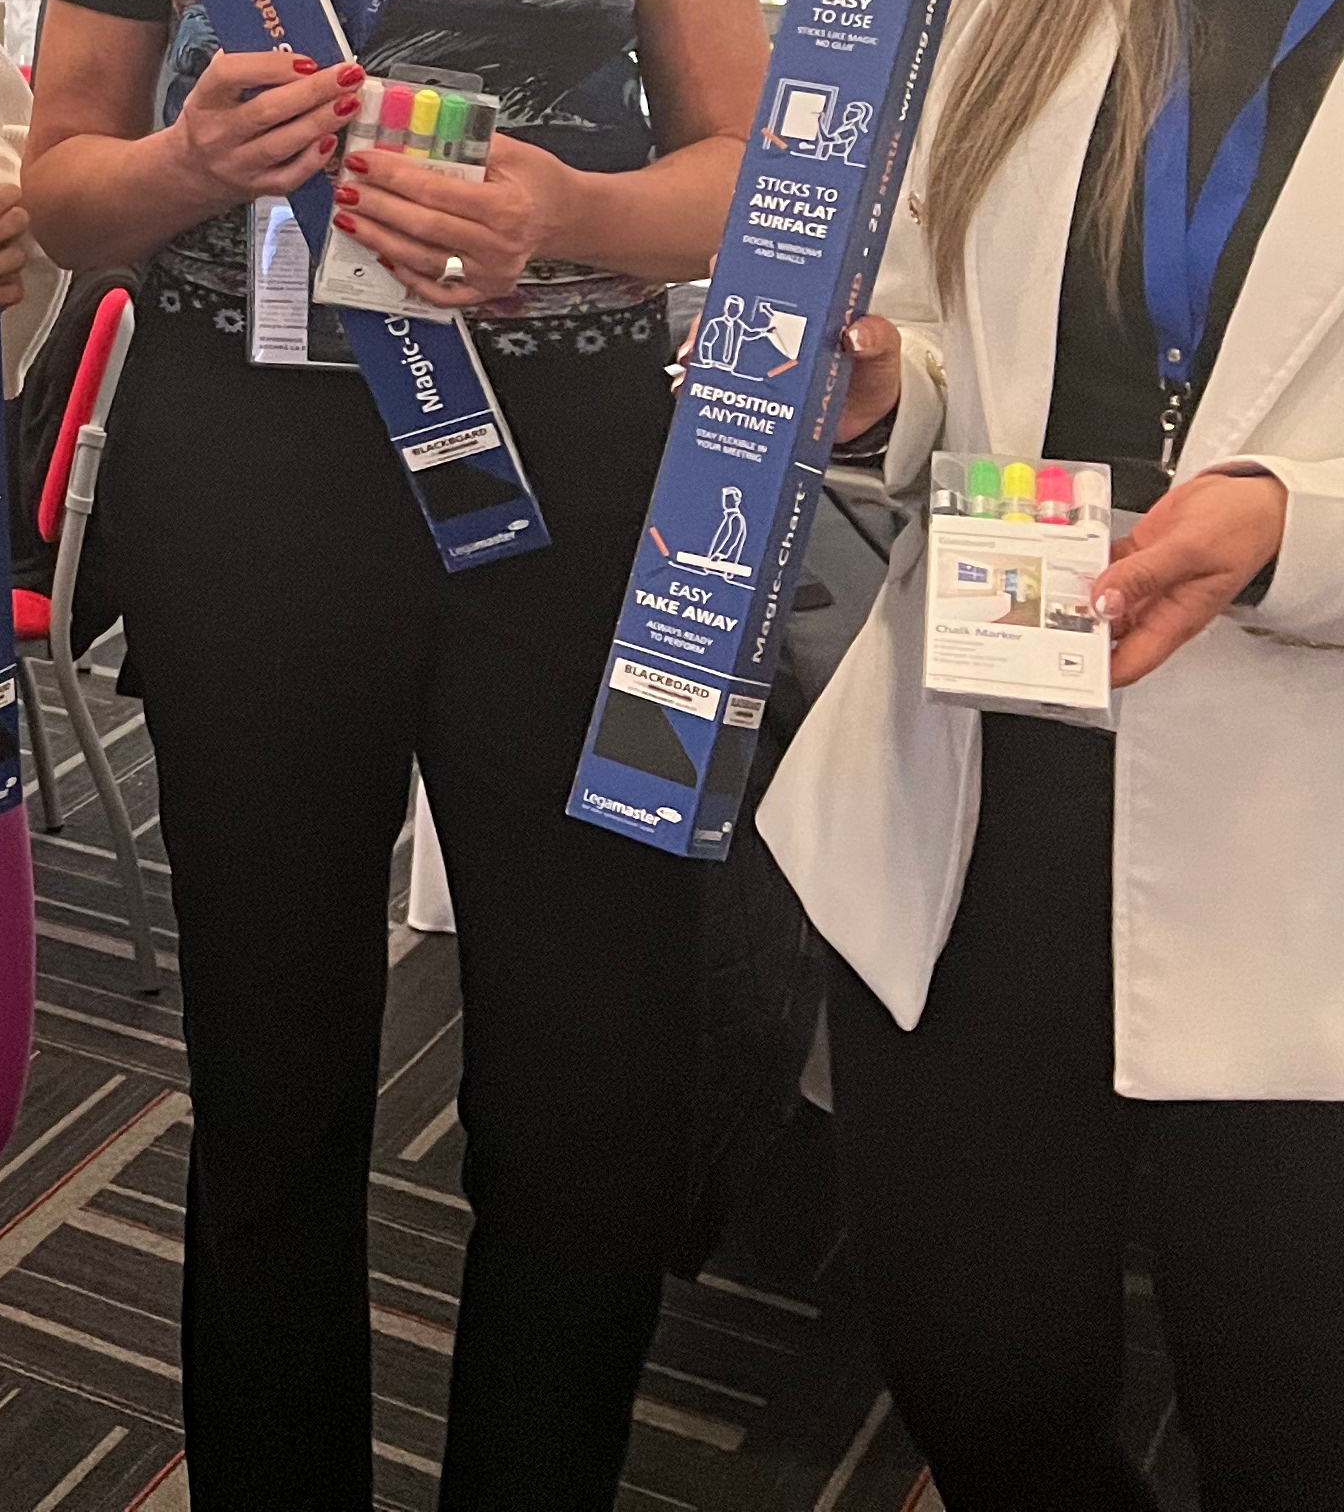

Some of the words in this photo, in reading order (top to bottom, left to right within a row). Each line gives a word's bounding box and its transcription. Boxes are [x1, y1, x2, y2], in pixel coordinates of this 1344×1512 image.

[812, 7, 837, 24] TO
[840, 12, 873, 30] USE
[756, 175, 810, 198] STICKS
[816, 186, 838, 203] TO
[749, 193, 791, 214] ANY
[793, 200, 837, 222] FLAT
[749, 211, 828, 239] SURFACE
[384, 314, 444, 415] Magic-C
[690, 382, 795, 420] REPOSITION
[698, 404, 777, 436] ANYTIME
[412, 427, 487, 456] BLACKBOARD
[718, 433, 756, 451] FLEXIBLE
[722, 446, 763, 463] MEETING
[668, 580, 714, 605] EASY
[634, 589, 680, 616] TAKE
[682, 605, 738, 633] AWAY
[662, 634, 706, 655] PERFORM
[935, 624, 970, 636] Chalk
[974, 628, 1023, 640] Marker
[623, 663, 711, 699] BLACKBOARD
[583, 789, 662, 827] Legamaster
